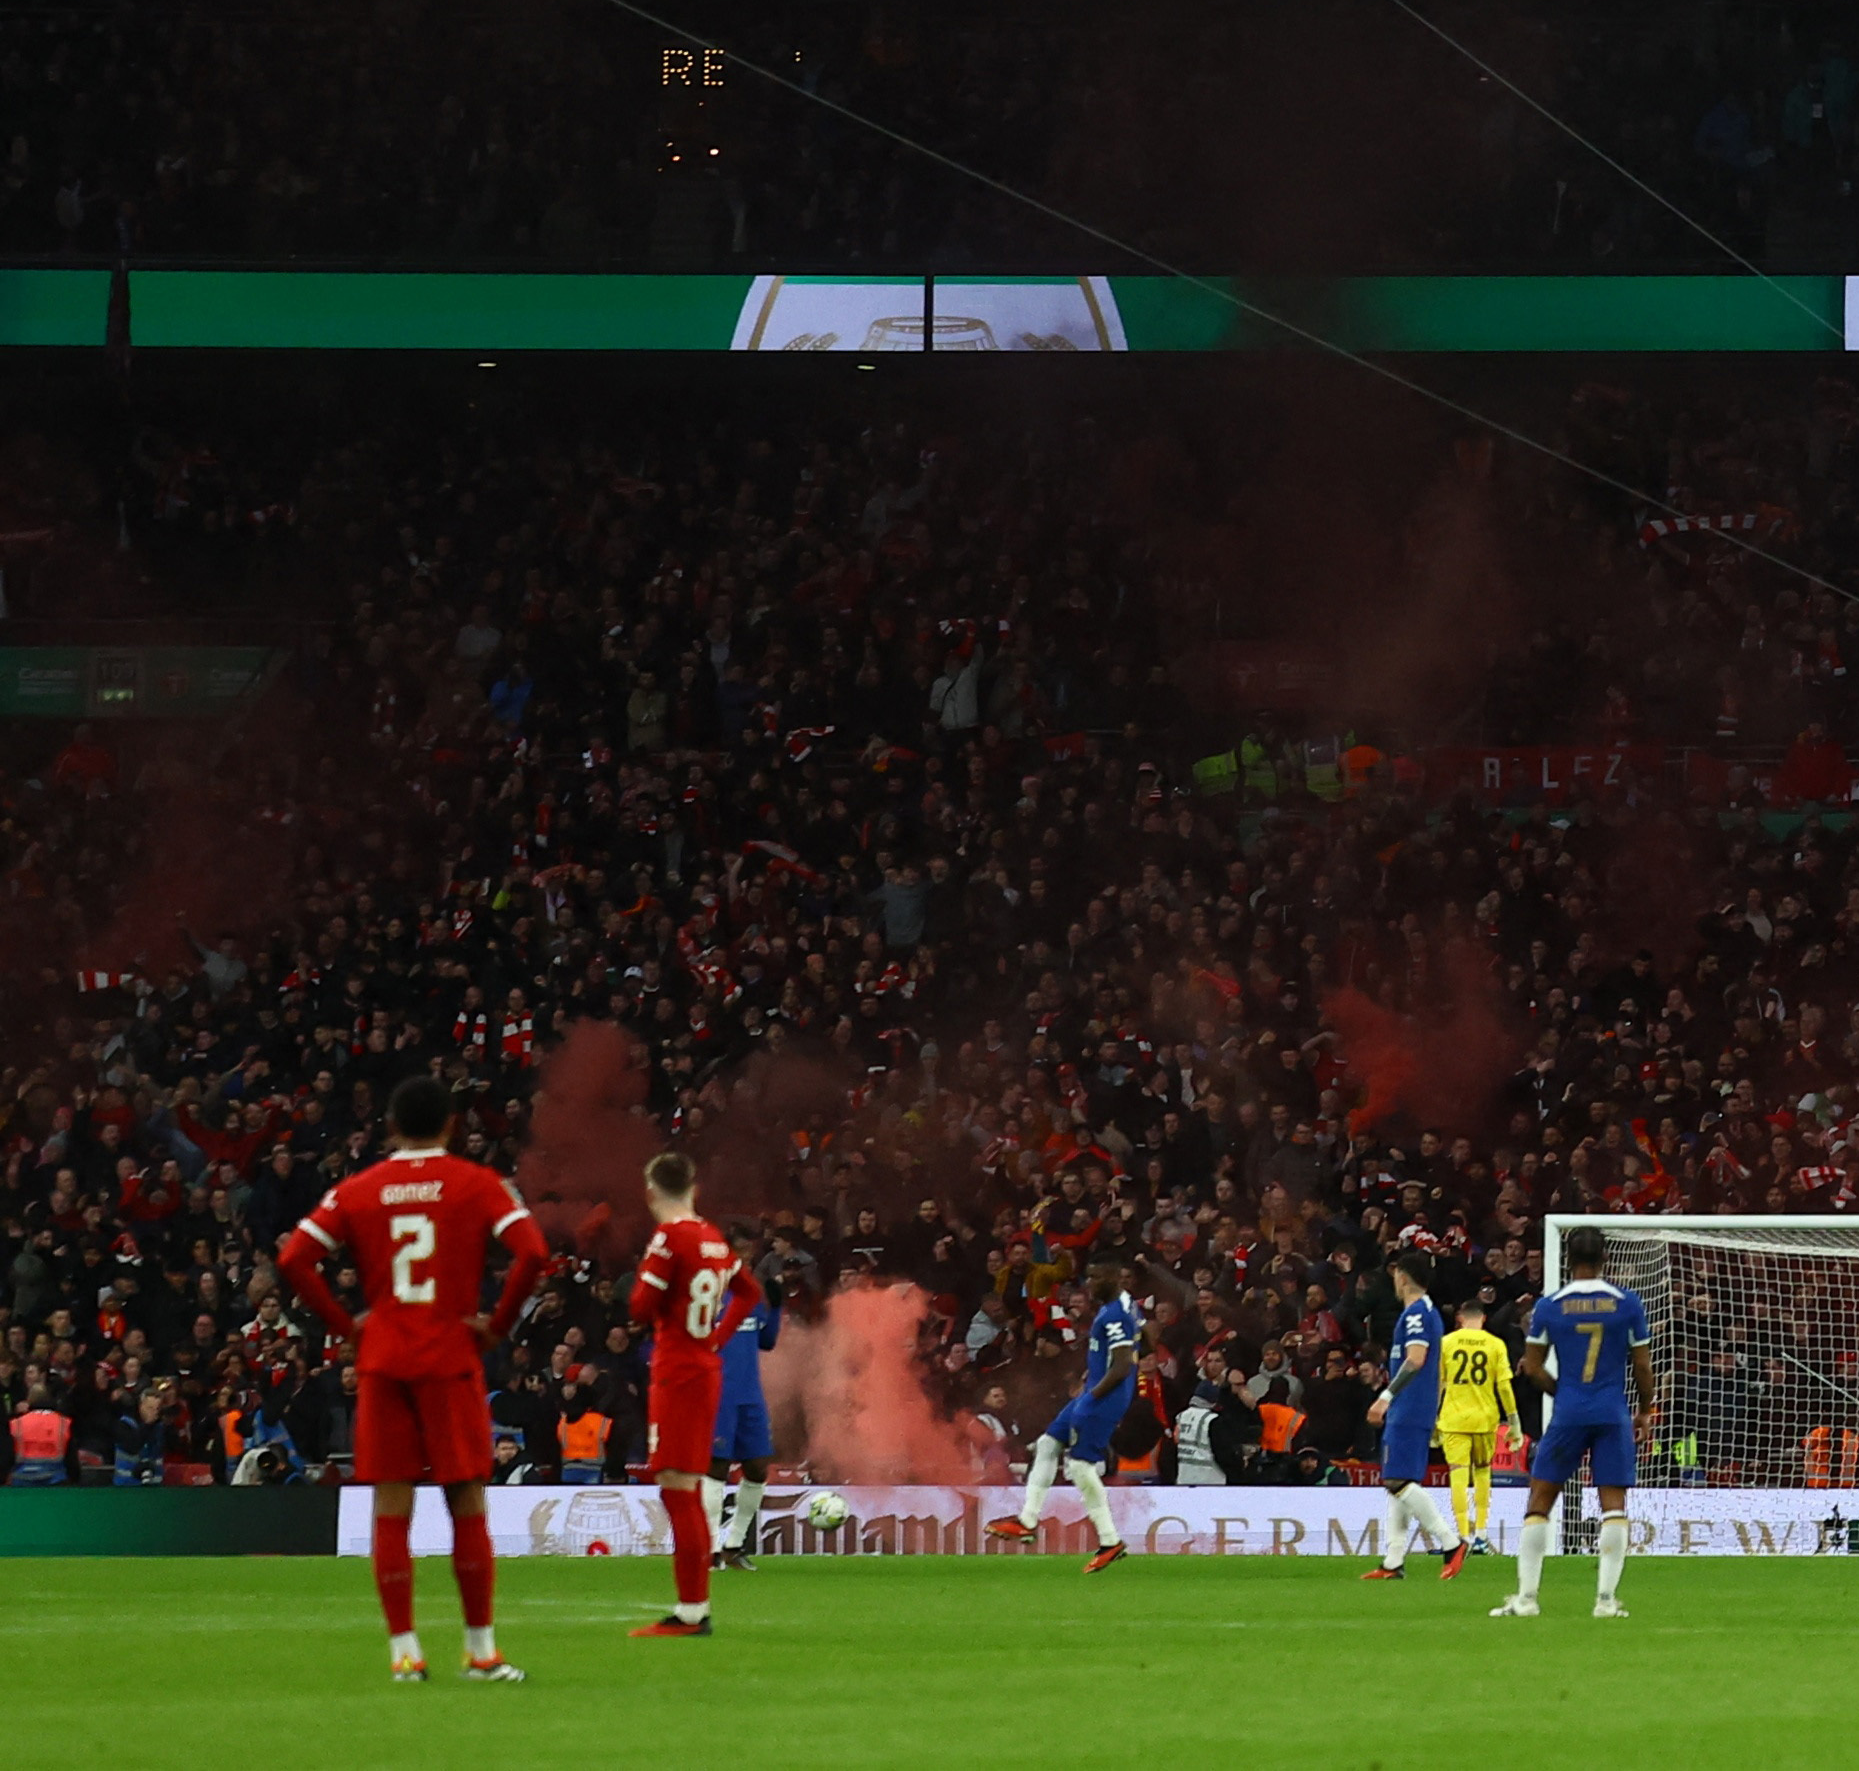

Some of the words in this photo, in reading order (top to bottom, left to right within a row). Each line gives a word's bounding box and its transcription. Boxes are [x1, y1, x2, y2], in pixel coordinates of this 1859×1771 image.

[661, 47, 727, 89] RE
[389, 1213, 437, 1304] 2
[1452, 1349, 1489, 1386] 28
[1575, 1322, 1606, 1384] 7
